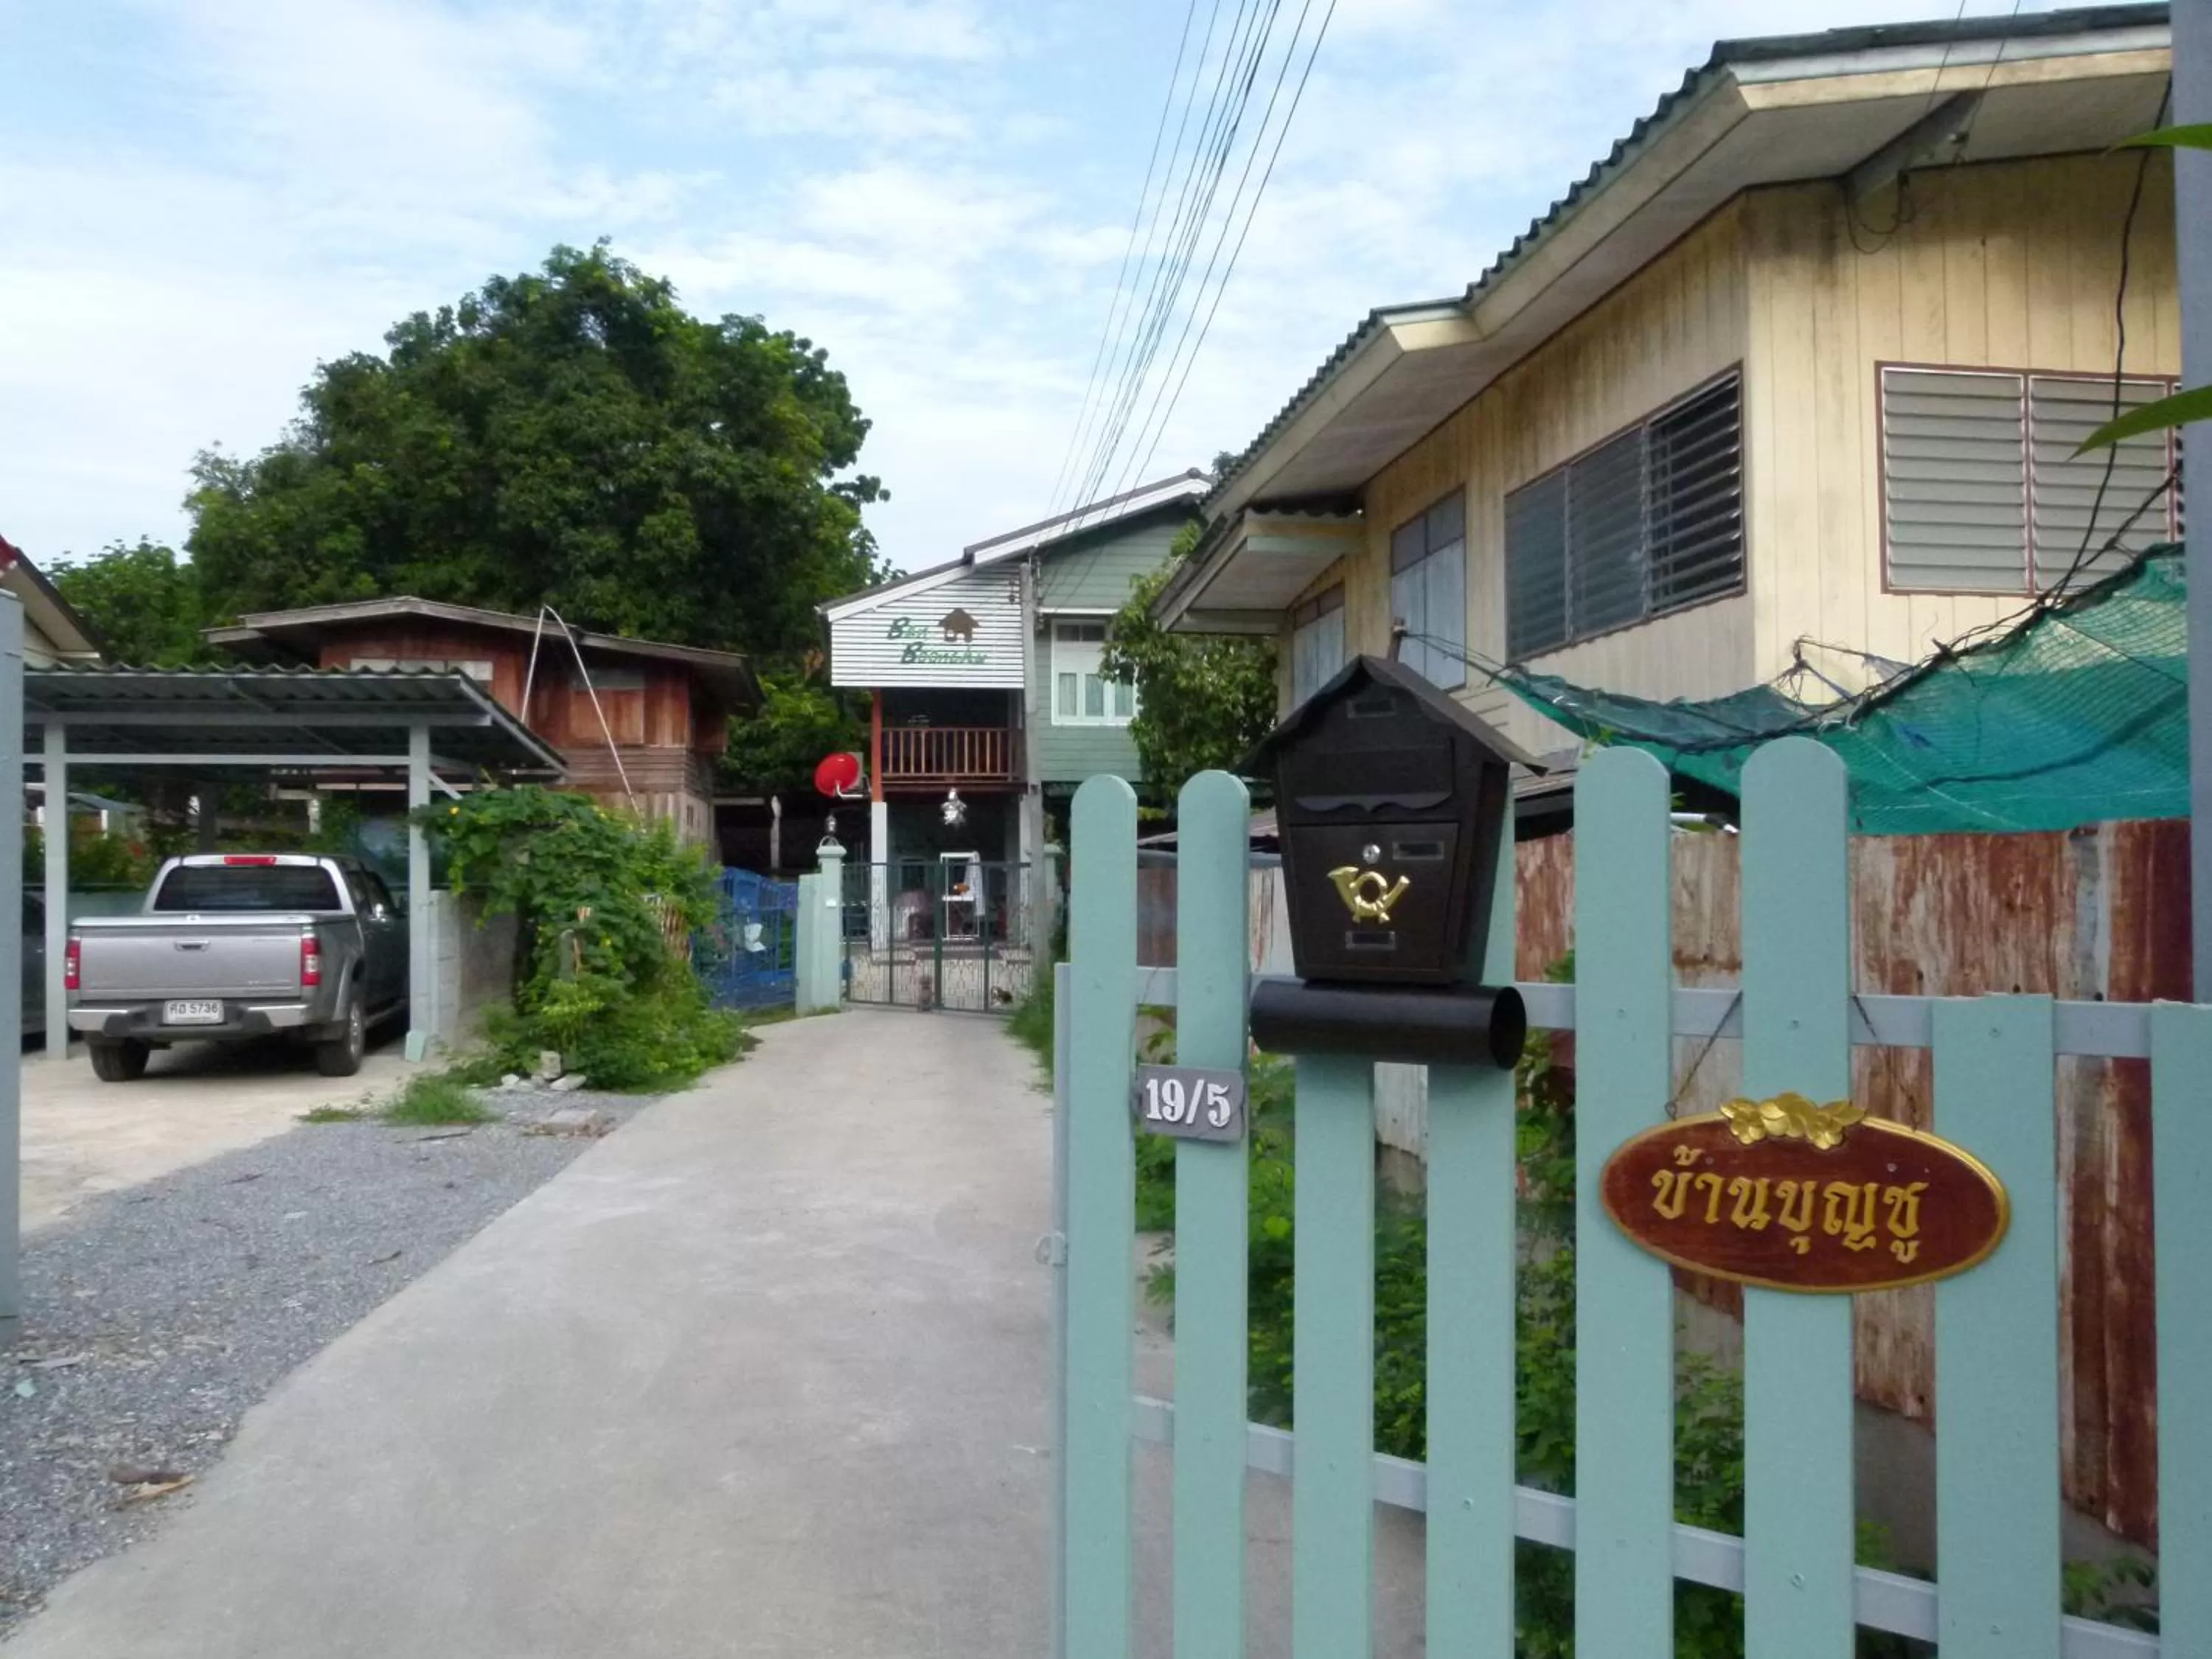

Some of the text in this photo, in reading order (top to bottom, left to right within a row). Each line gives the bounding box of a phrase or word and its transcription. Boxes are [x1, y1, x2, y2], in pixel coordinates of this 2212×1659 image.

[1145, 1078, 1231, 1128] 19/5
[1651, 1144, 1928, 1263] บ้านบุญชู
